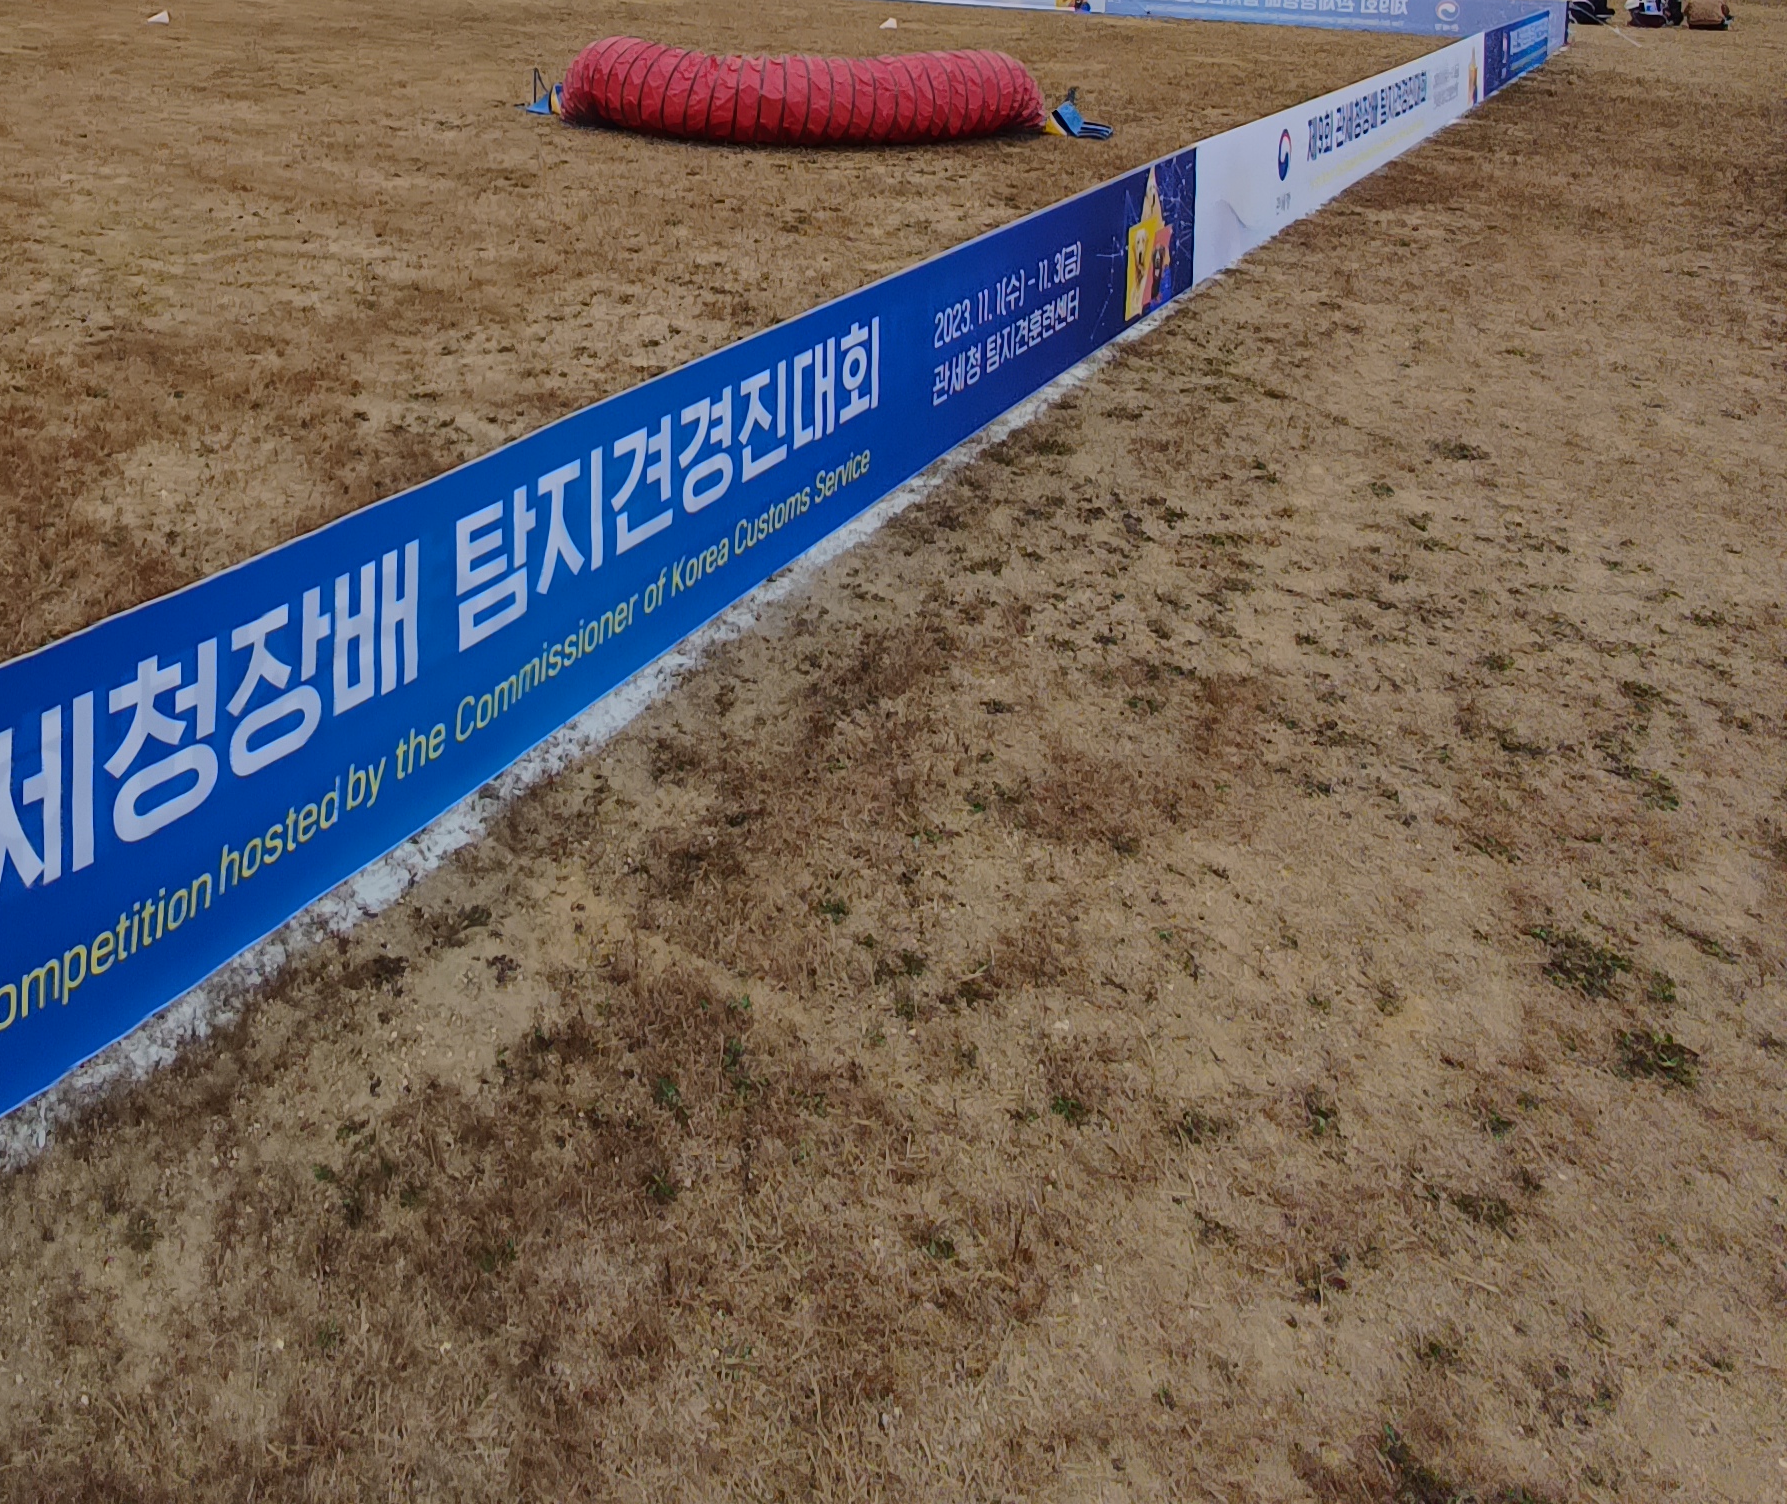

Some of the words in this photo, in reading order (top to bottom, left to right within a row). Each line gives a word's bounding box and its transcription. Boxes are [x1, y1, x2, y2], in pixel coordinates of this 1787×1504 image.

[932, 351, 981, 407] 관세청
[986, 287, 1080, 374] 탐지견훈련센터
[934, 310, 973, 349] 2023.
[978, 289, 993, 325] 11.
[996, 269, 1025, 318] 1(수)
[1038, 261, 1052, 292] 11.
[1054, 240, 1082, 285] 3(금)
[456, 315, 880, 653] 탐지견경진대회
[219, 775, 341, 886] hosted
[345, 755, 387, 813] by
[395, 721, 446, 782] the
[455, 592, 640, 743] Commissioner
[643, 566, 668, 614] of
[670, 536, 729, 598] Korea
[733, 483, 811, 556] Customs
[814, 448, 871, 505] Service
